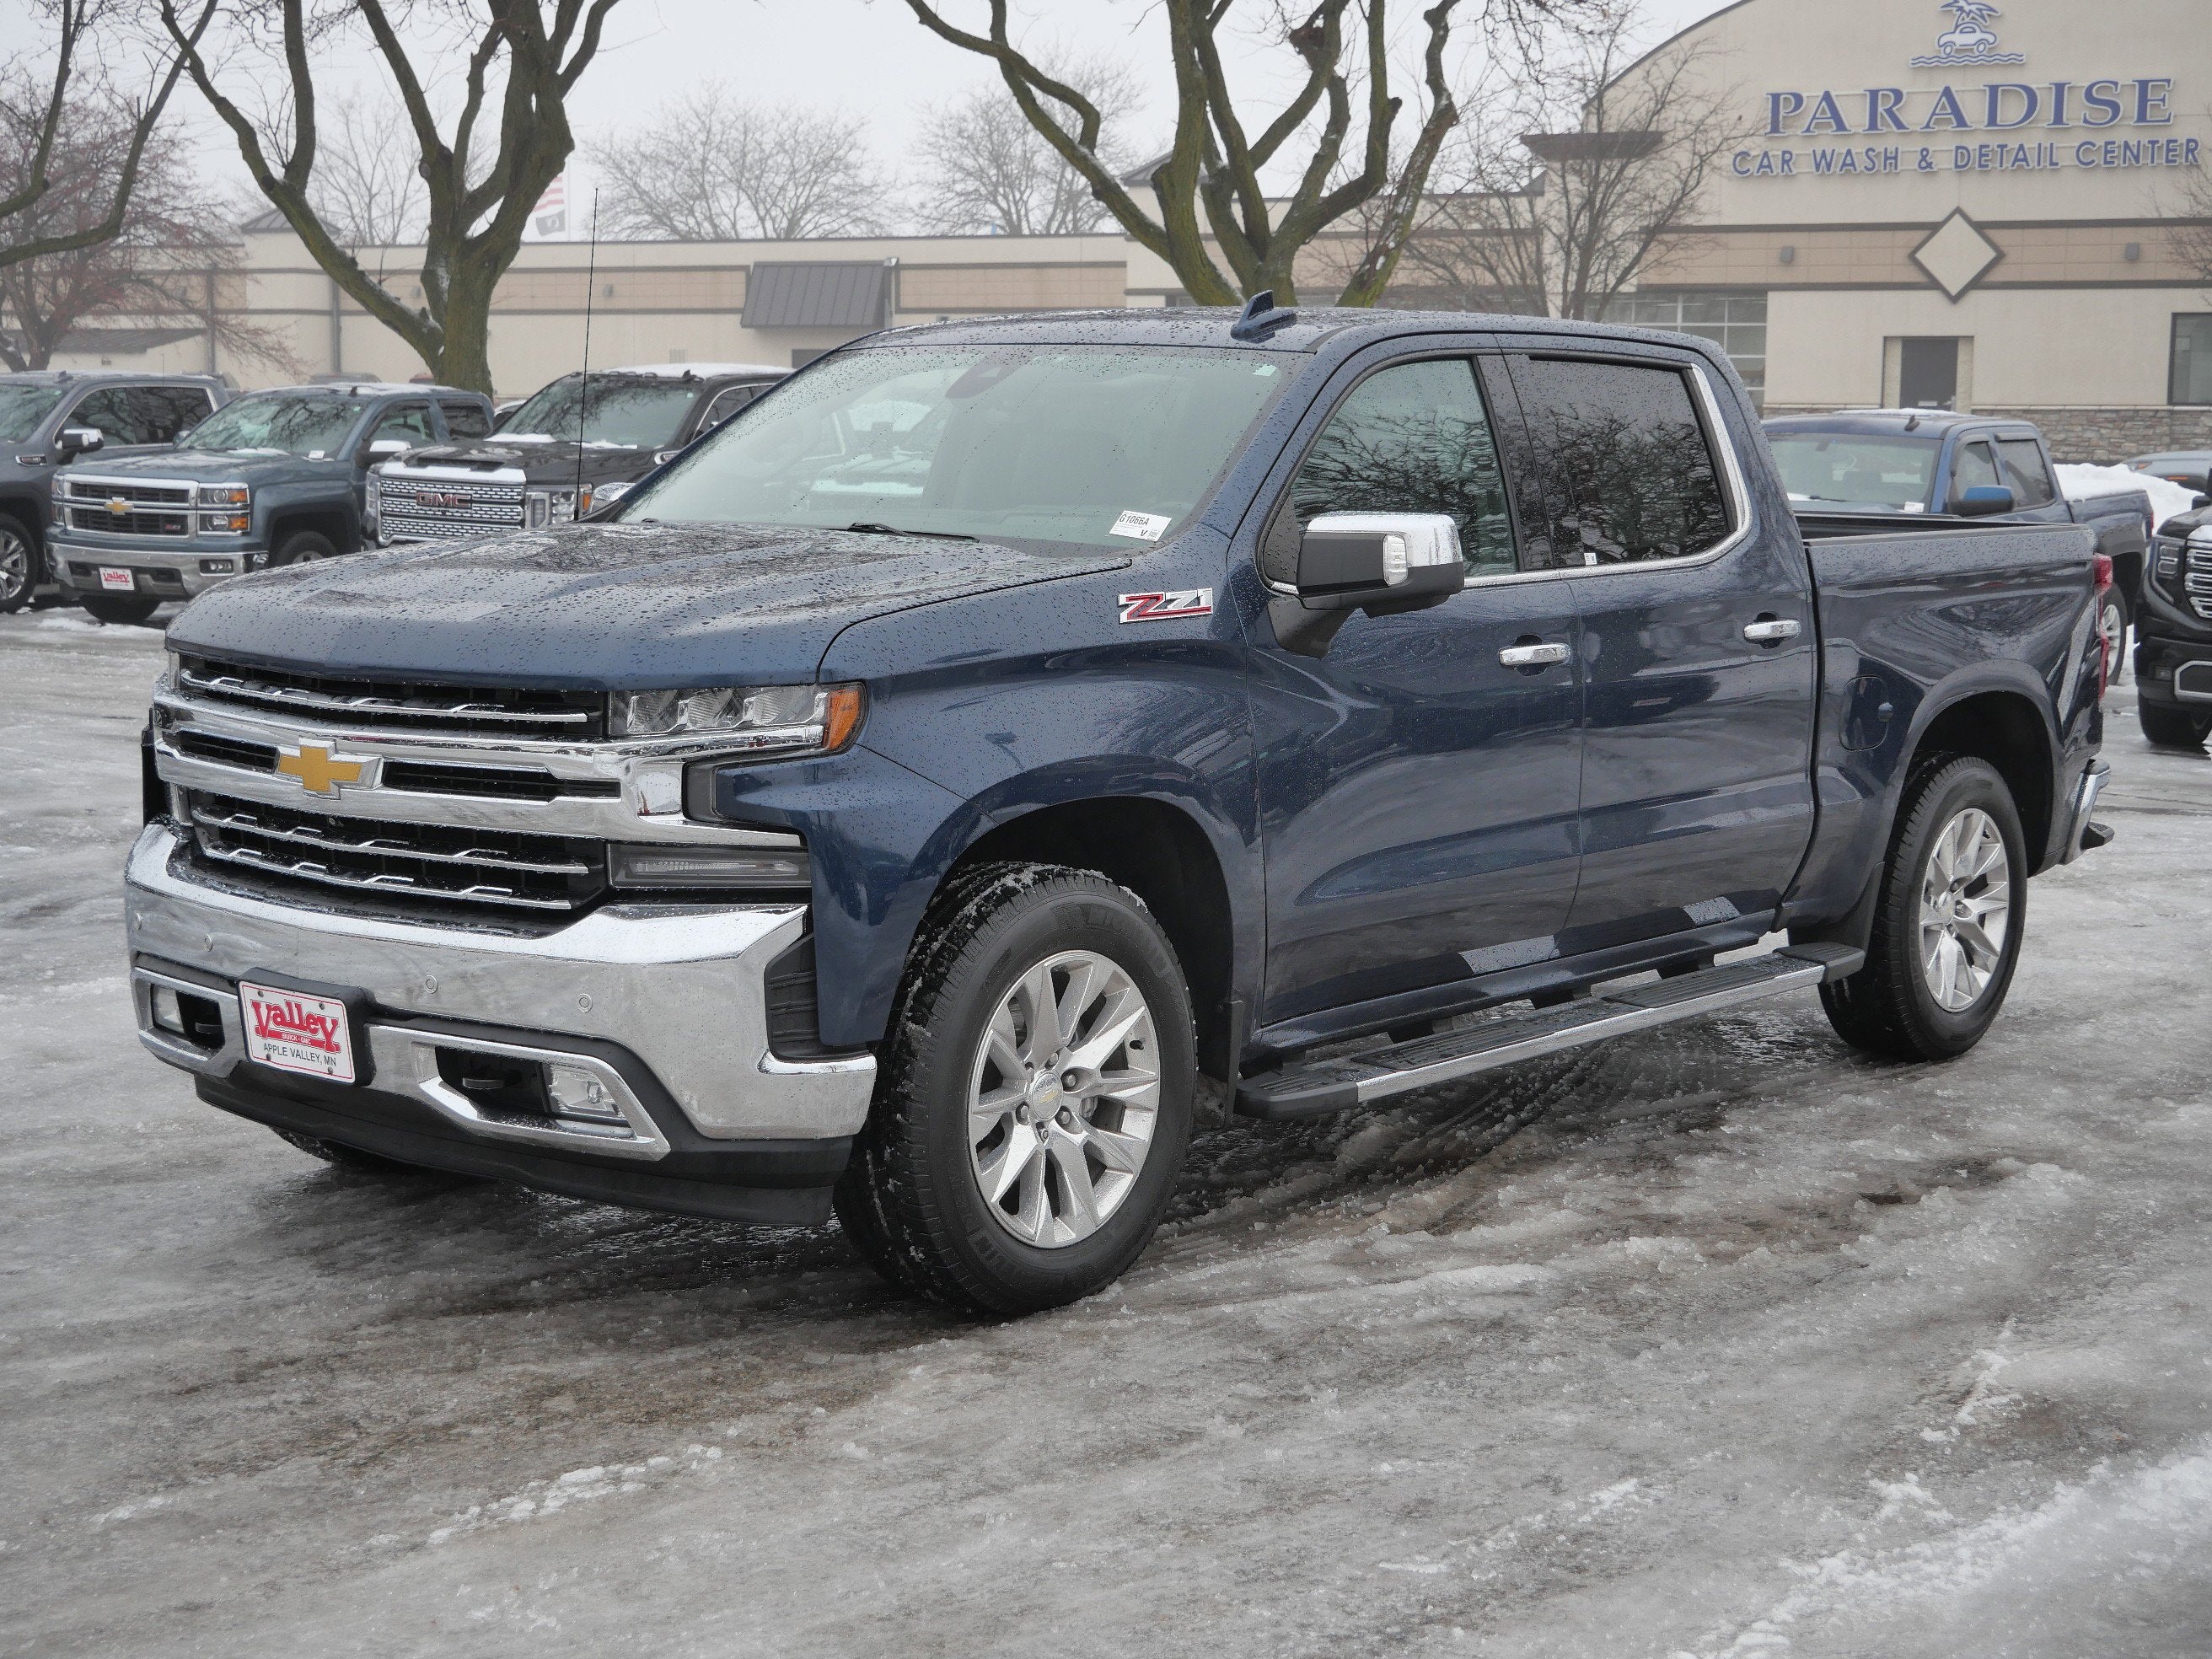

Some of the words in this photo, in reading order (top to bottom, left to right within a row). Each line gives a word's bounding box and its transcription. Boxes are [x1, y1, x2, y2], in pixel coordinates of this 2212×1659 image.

[1764, 78, 2175, 135] PARADISE
[1732, 148, 1796, 176] CAR
[1812, 146, 1901, 174] WASH
[1917, 147, 1936, 171] &
[1953, 142, 2059, 169] DETAIL
[2075, 137, 2201, 167] CENTER
[416, 492, 471, 507] GMC
[1118, 588, 1213, 624] Z71
[251, 999, 341, 1054] Valley
[264, 1042, 287, 1056] APPLE
[290, 1047, 322, 1065] VALLEY,
[324, 1055, 336, 1066] MN
